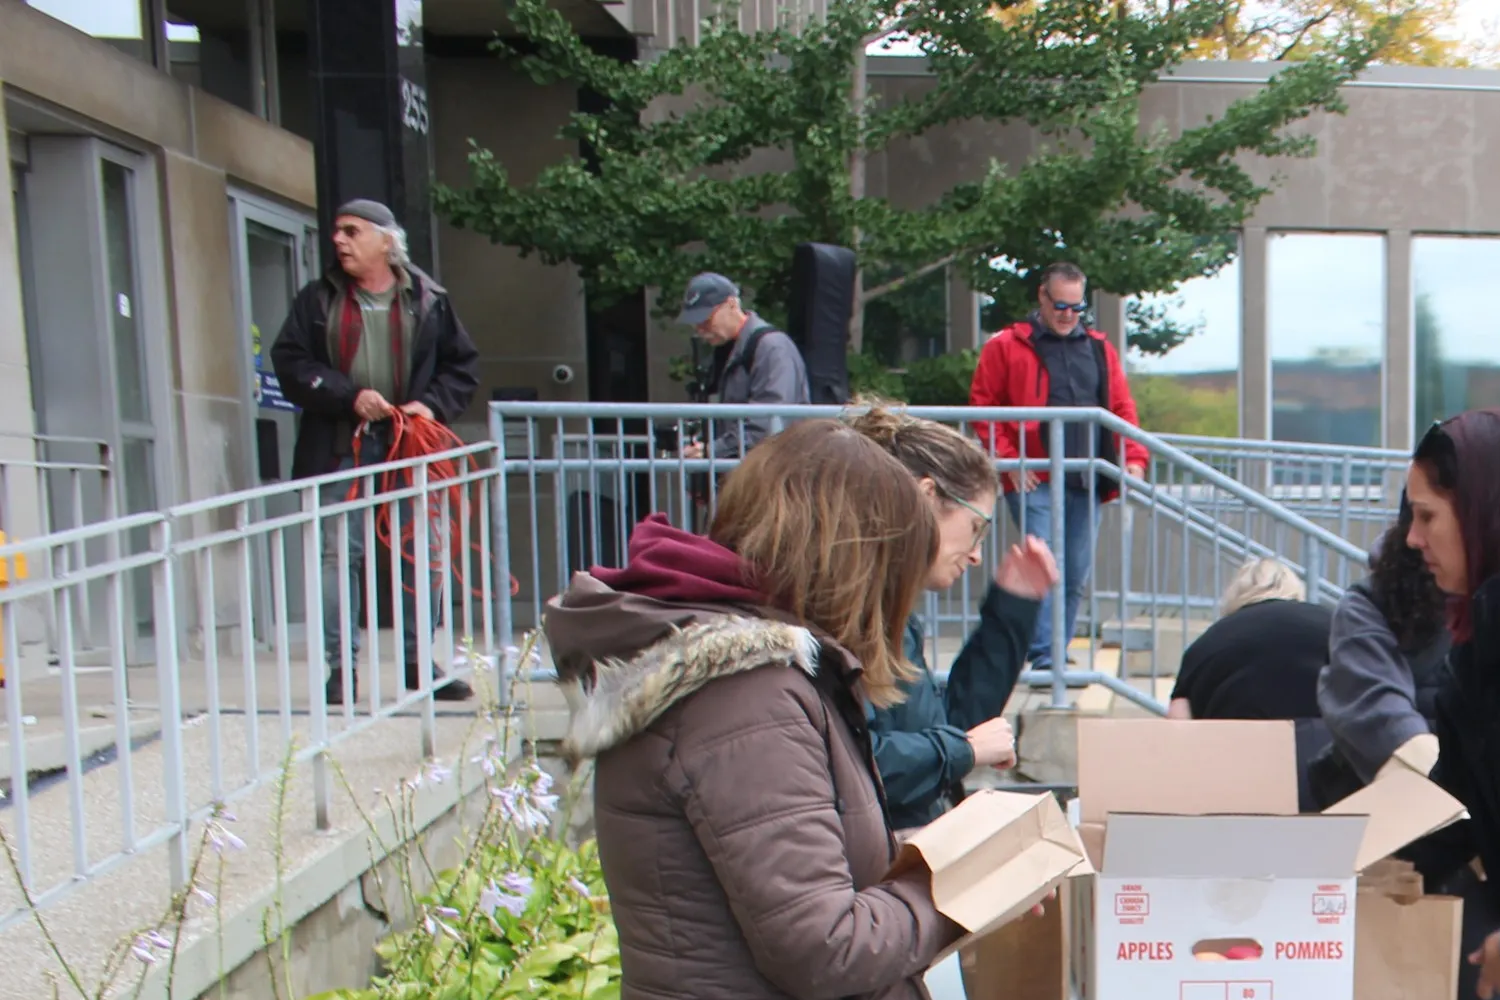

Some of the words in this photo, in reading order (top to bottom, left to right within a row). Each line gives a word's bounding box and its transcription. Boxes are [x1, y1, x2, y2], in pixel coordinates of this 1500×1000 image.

[402, 79, 429, 135] 255
[1116, 942, 1173, 960] APPLES
[1275, 941, 1343, 960] POMMES
